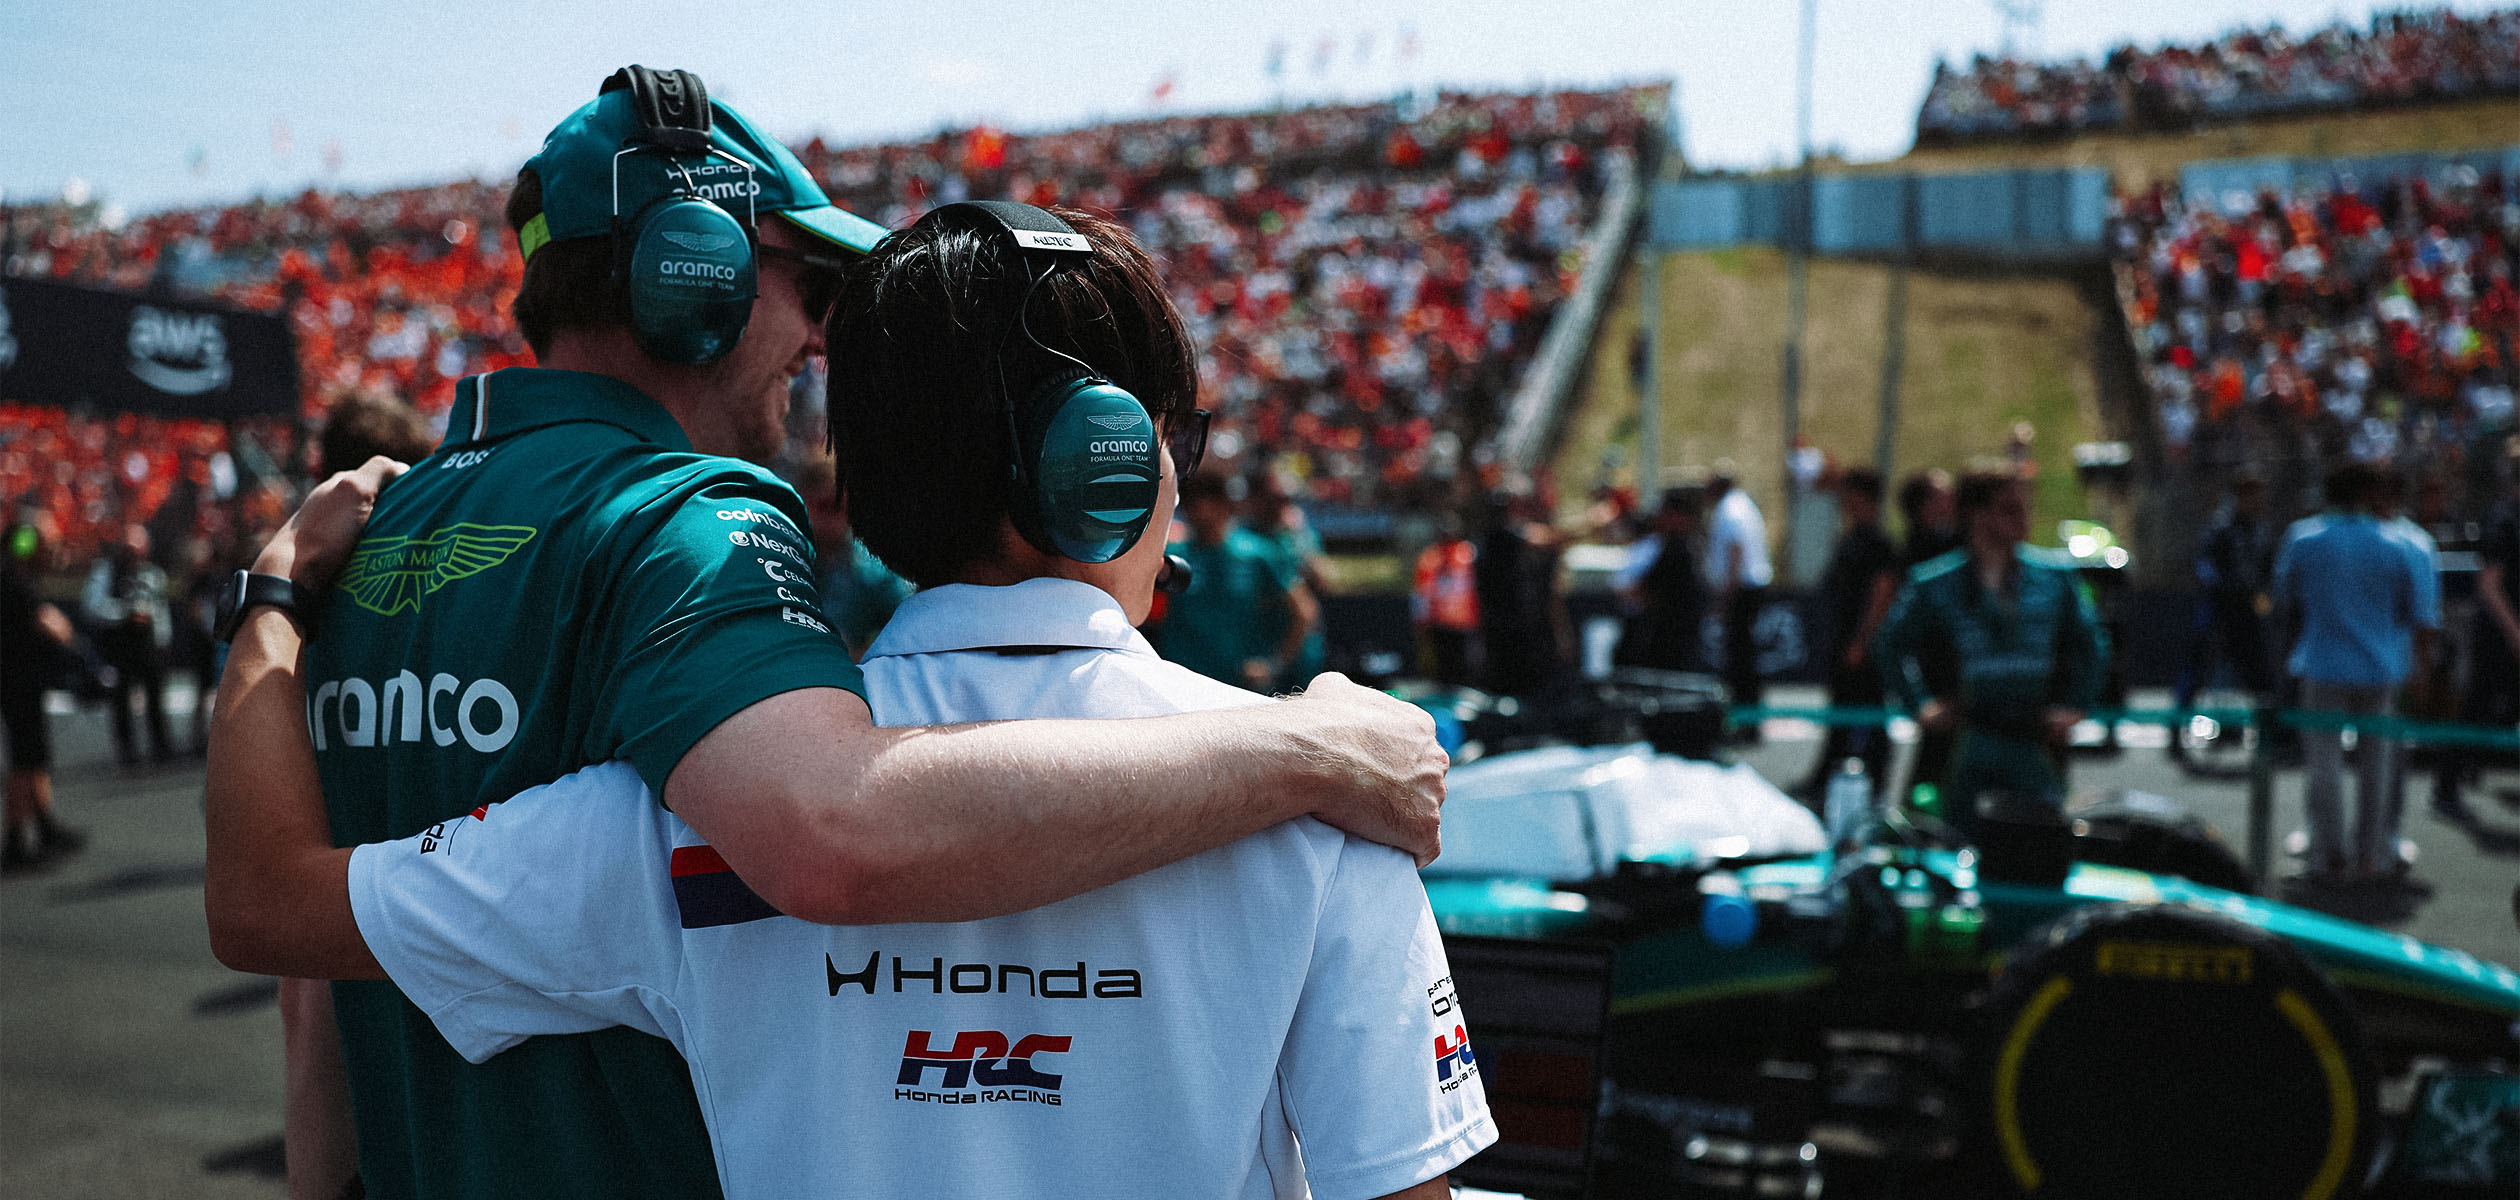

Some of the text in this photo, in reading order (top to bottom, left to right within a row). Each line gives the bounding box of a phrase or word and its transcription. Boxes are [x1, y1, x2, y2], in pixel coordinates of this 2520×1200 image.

[660, 260, 736, 280] aramco
[441, 447, 496, 470] BOS
[1090, 440, 1148, 453] aramco
[749, 531, 816, 582] NexG
[306, 668, 519, 753] ramco
[893, 957, 1143, 999] Honda
[896, 1030, 1073, 1090] HRC
[1434, 1024, 1475, 1083] HR
[895, 1089, 1062, 1107] Honda RACING
